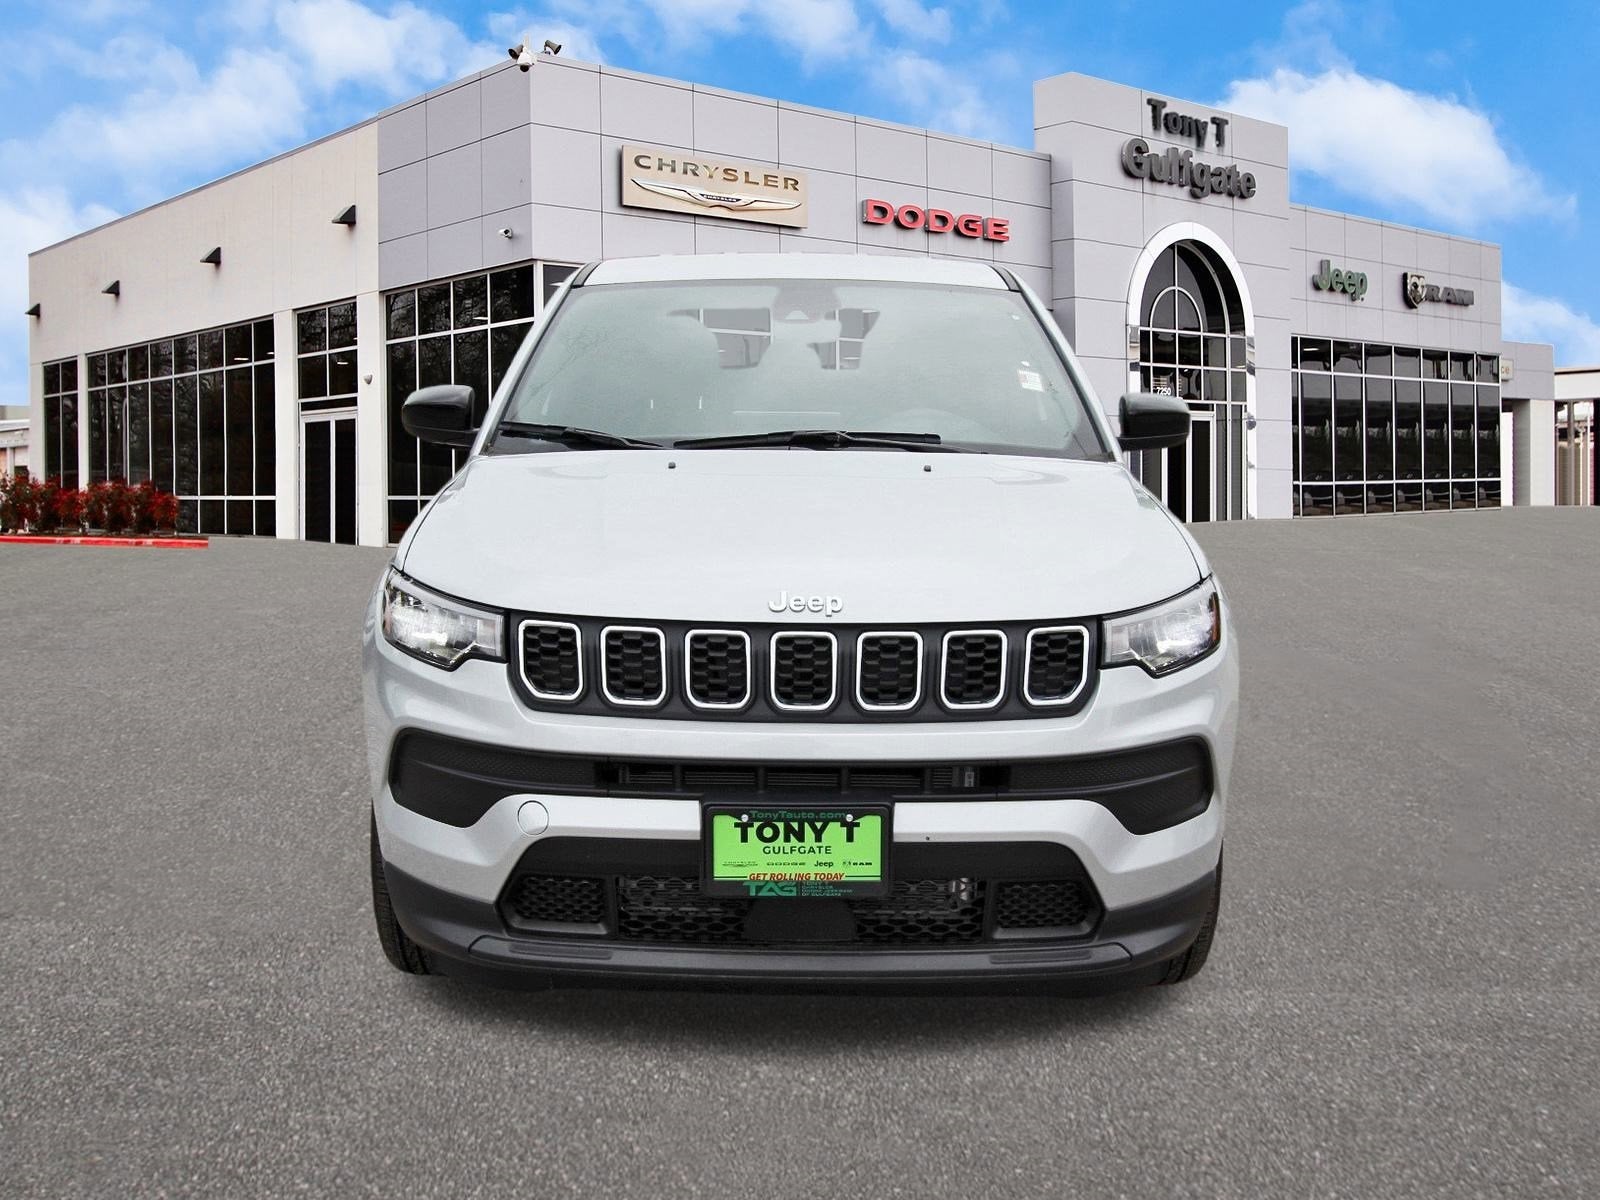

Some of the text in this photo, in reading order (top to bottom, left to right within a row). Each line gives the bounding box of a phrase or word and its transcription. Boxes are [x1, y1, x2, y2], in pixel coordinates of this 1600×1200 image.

[1147, 98, 1229, 147] Tony T
[633, 153, 801, 192] CHRYSLER
[1121, 138, 1256, 198] Gulfgate
[863, 198, 1011, 242] DODGE
[1313, 259, 1368, 301] Jeep
[1424, 283, 1475, 306] RAM
[1156, 387, 1171, 396] 7250
[768, 590, 843, 617] Jeep
[734, 821, 860, 844] TONY T
[762, 845, 832, 855] GULFGATE
[814, 860, 834, 868] Jeep
[749, 872, 845, 881] GET ROLLING TODAY
[743, 881, 797, 897] TAG
